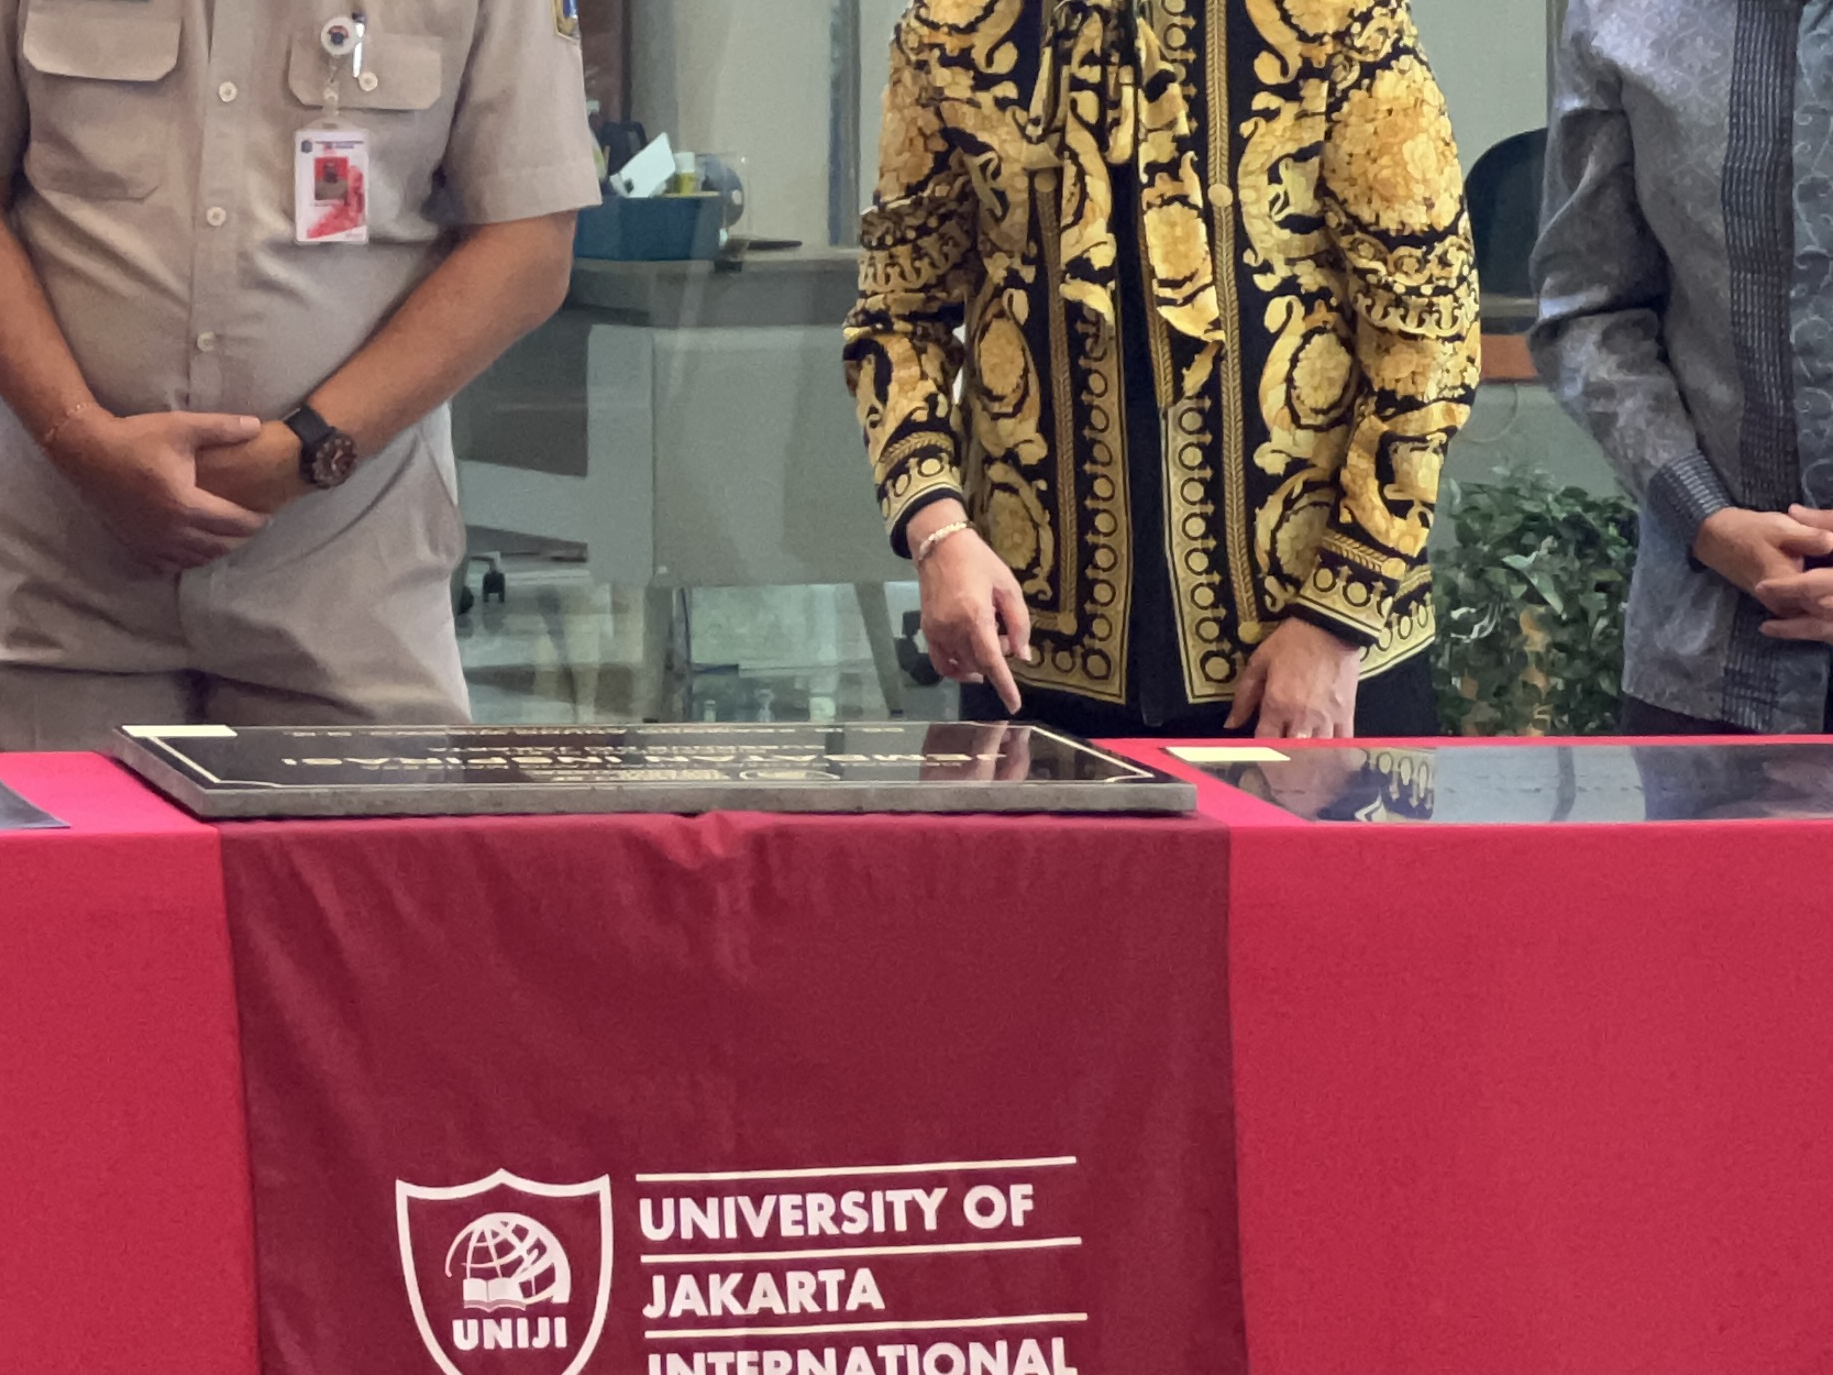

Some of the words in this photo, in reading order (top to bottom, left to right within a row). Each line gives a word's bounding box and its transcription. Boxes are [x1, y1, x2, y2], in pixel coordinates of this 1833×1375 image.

[639, 1187, 948, 1241] UNIVERSITY
[963, 1183, 1034, 1230] OF
[642, 1268, 886, 1319] JAKARTA
[452, 1316, 567, 1351] UNIJI
